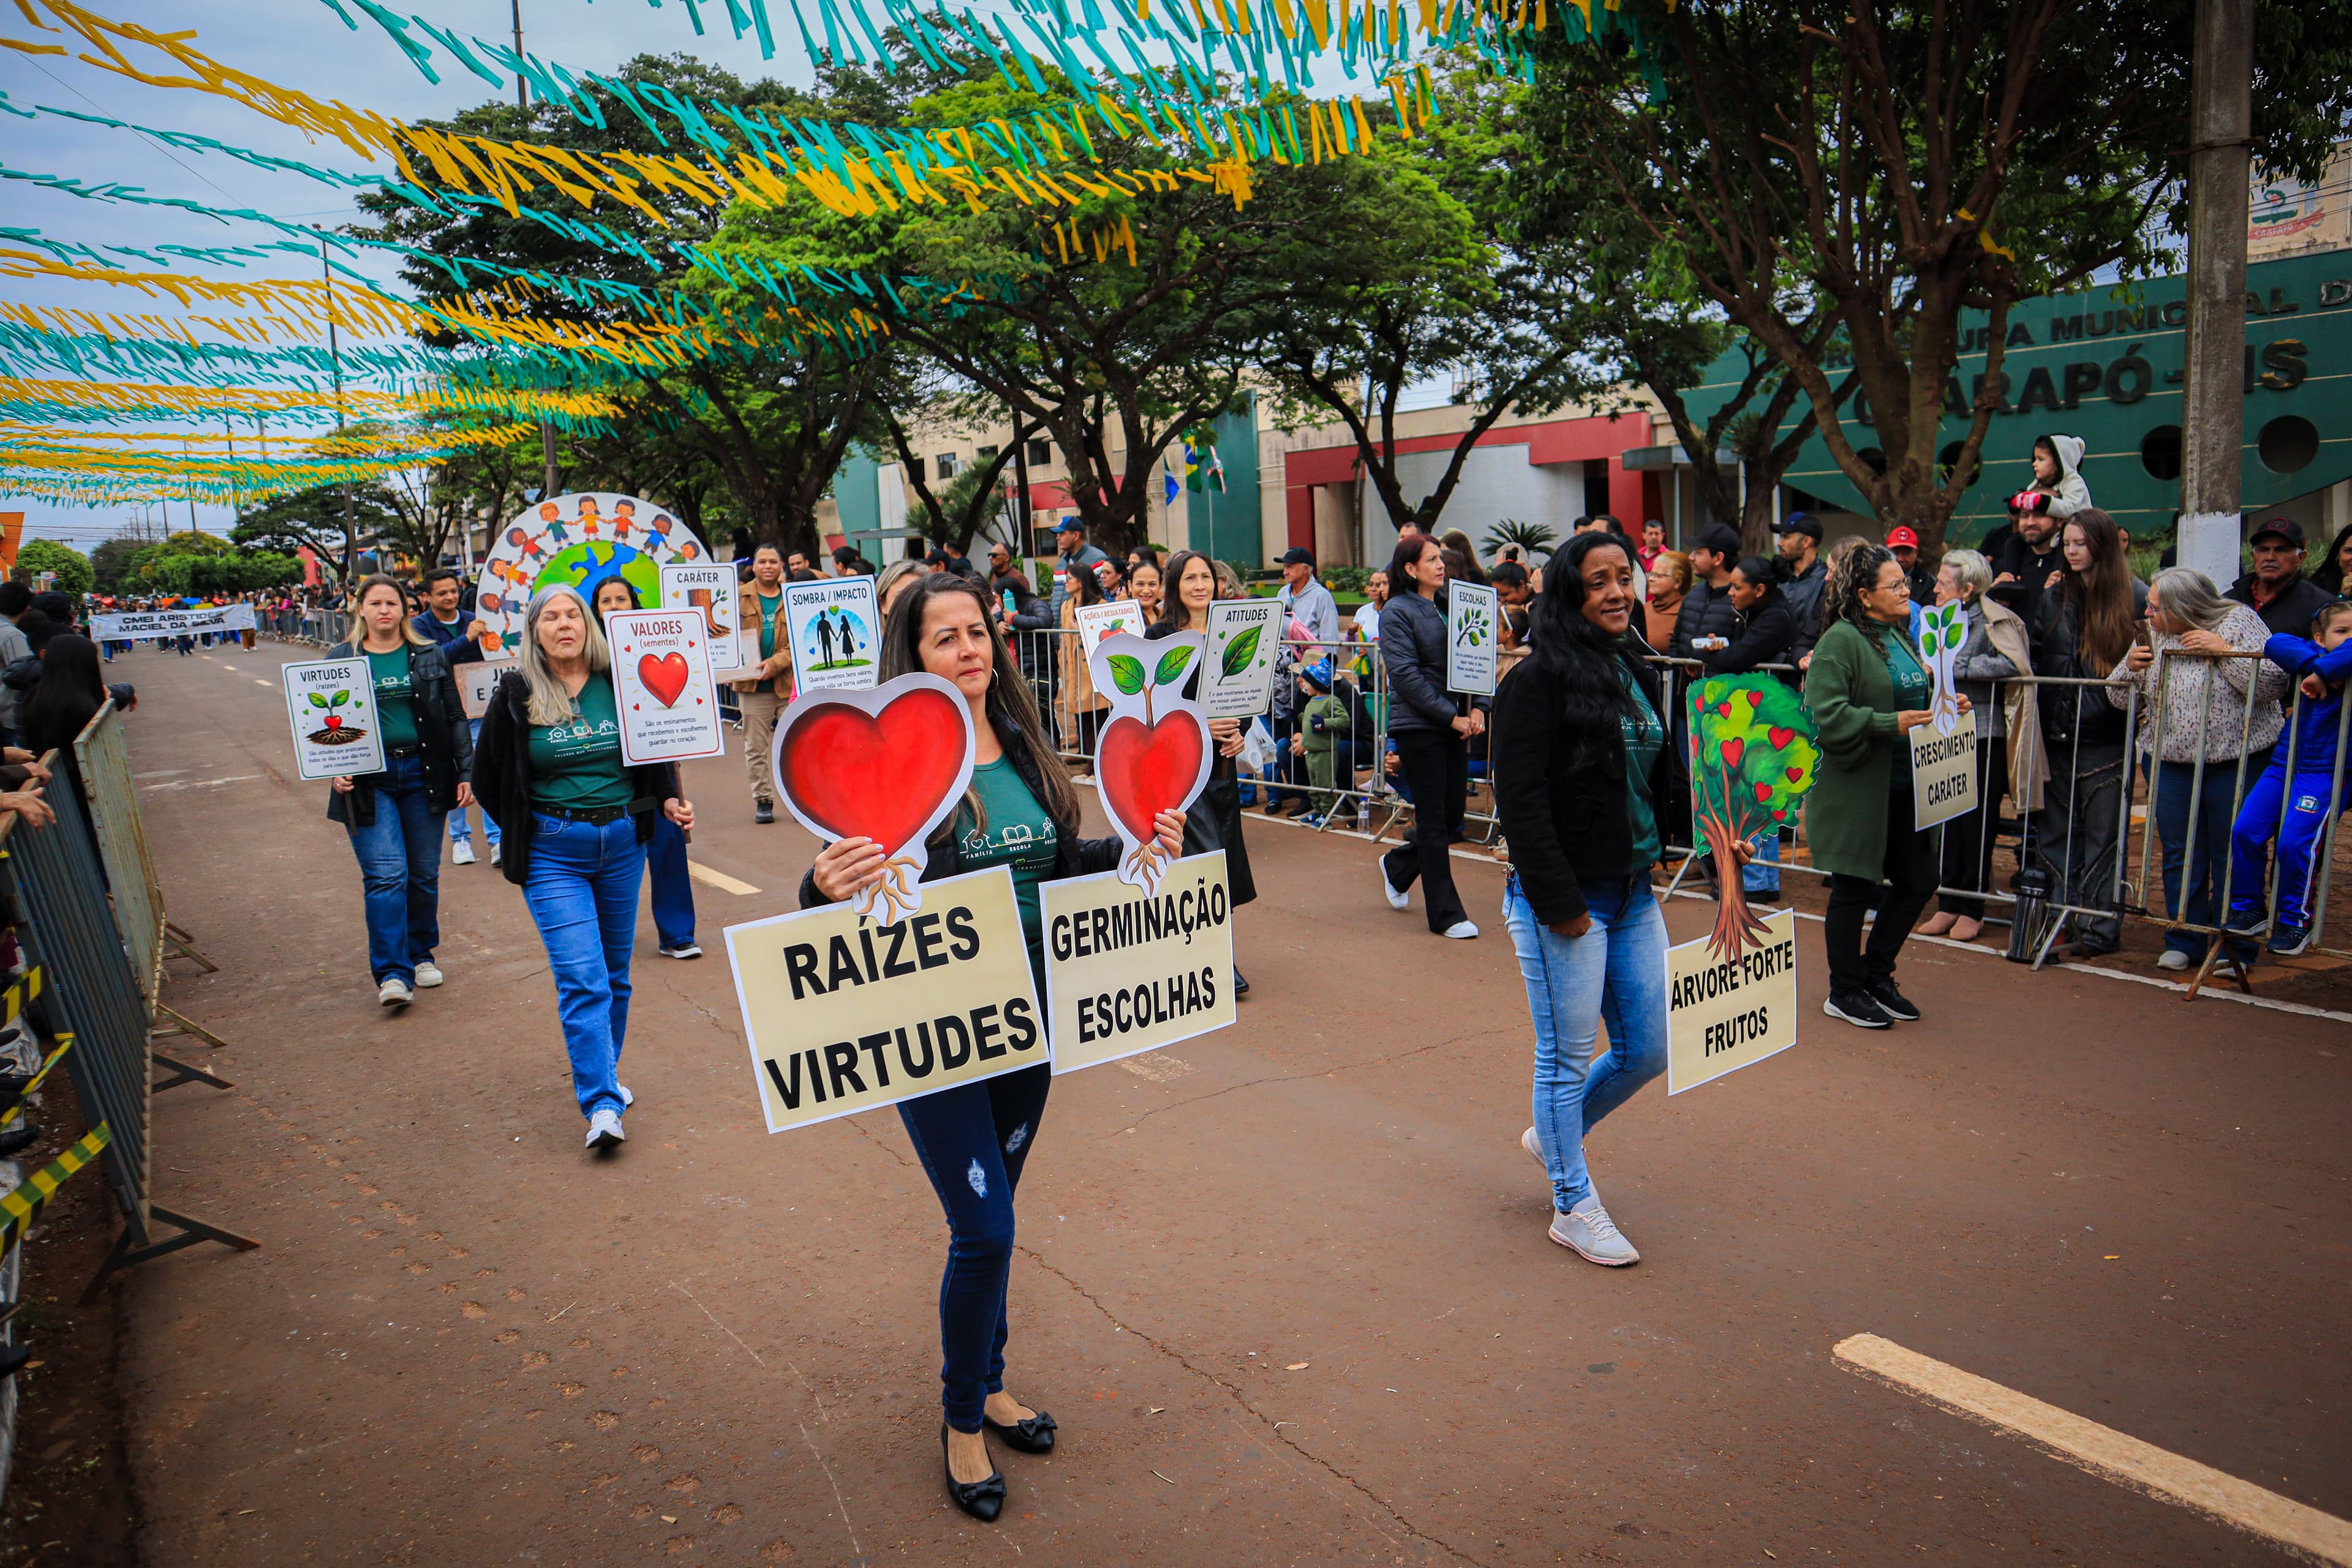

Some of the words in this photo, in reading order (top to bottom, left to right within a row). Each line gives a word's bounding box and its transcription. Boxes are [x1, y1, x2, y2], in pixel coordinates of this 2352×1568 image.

[2051, 287, 2299, 342] MUNICAL
[677, 570, 719, 583] CARÁTER
[793, 592, 826, 605] SOMBRA
[827, 590, 831, 602] /
[833, 587, 867, 601] IMPACTO
[1459, 591, 1487, 606] ESCOLHAS
[123, 616, 154, 624] CMEI
[158, 611, 224, 621] ARISTIDES
[1084, 611, 1100, 621] AÇÕES
[1104, 607, 1134, 617] RESULTADOS
[1226, 608, 1268, 622] ATITUDES
[118, 624, 167, 632] MACIEL
[630, 620, 682, 637] VALORES
[640, 637, 679, 648] (sementes)
[300, 668, 350, 682] VIRTUDES
[649, 738, 668, 747] guardar
[1914, 729, 1975, 769] CRESCIMENTO
[1928, 773, 1967, 806] CARÁTER
[966, 850, 993, 859] FAMÍLIA
[1009, 843, 1031, 852] ESCOLA
[1051, 876, 1226, 962] GERMINAÇÃO
[783, 906, 981, 1000] RAÍZES
[1671, 960, 1740, 1011] ÁRVORE
[1743, 940, 1793, 986] FORTE
[1077, 967, 1216, 1044] ESCOLHAS
[1705, 1006, 1768, 1057] FRUTOS
[764, 997, 1037, 1110] VIRTUDES
